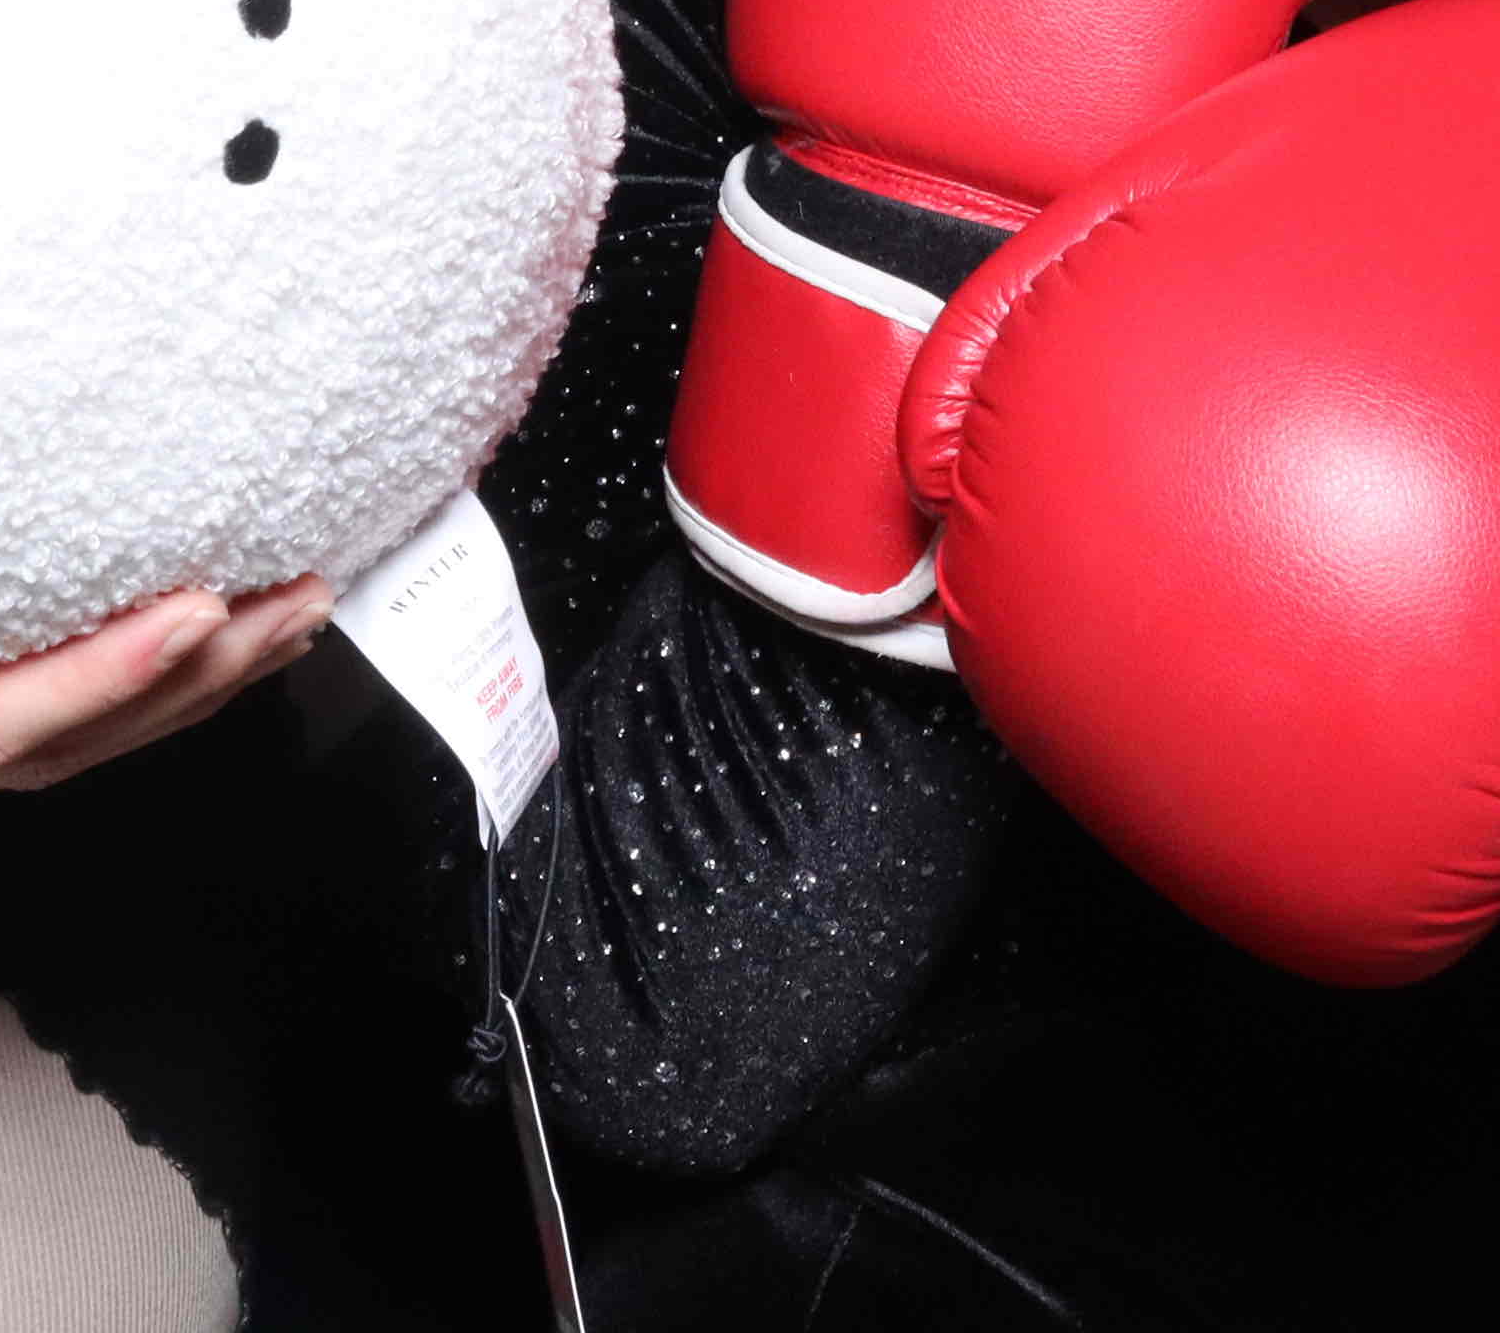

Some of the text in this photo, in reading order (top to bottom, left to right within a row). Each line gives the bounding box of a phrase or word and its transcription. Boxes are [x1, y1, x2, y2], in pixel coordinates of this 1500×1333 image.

[390, 543, 468, 613] WINTER
[475, 655, 518, 706] KEEP AWAY
[485, 673, 524, 723] FROM FIRE
